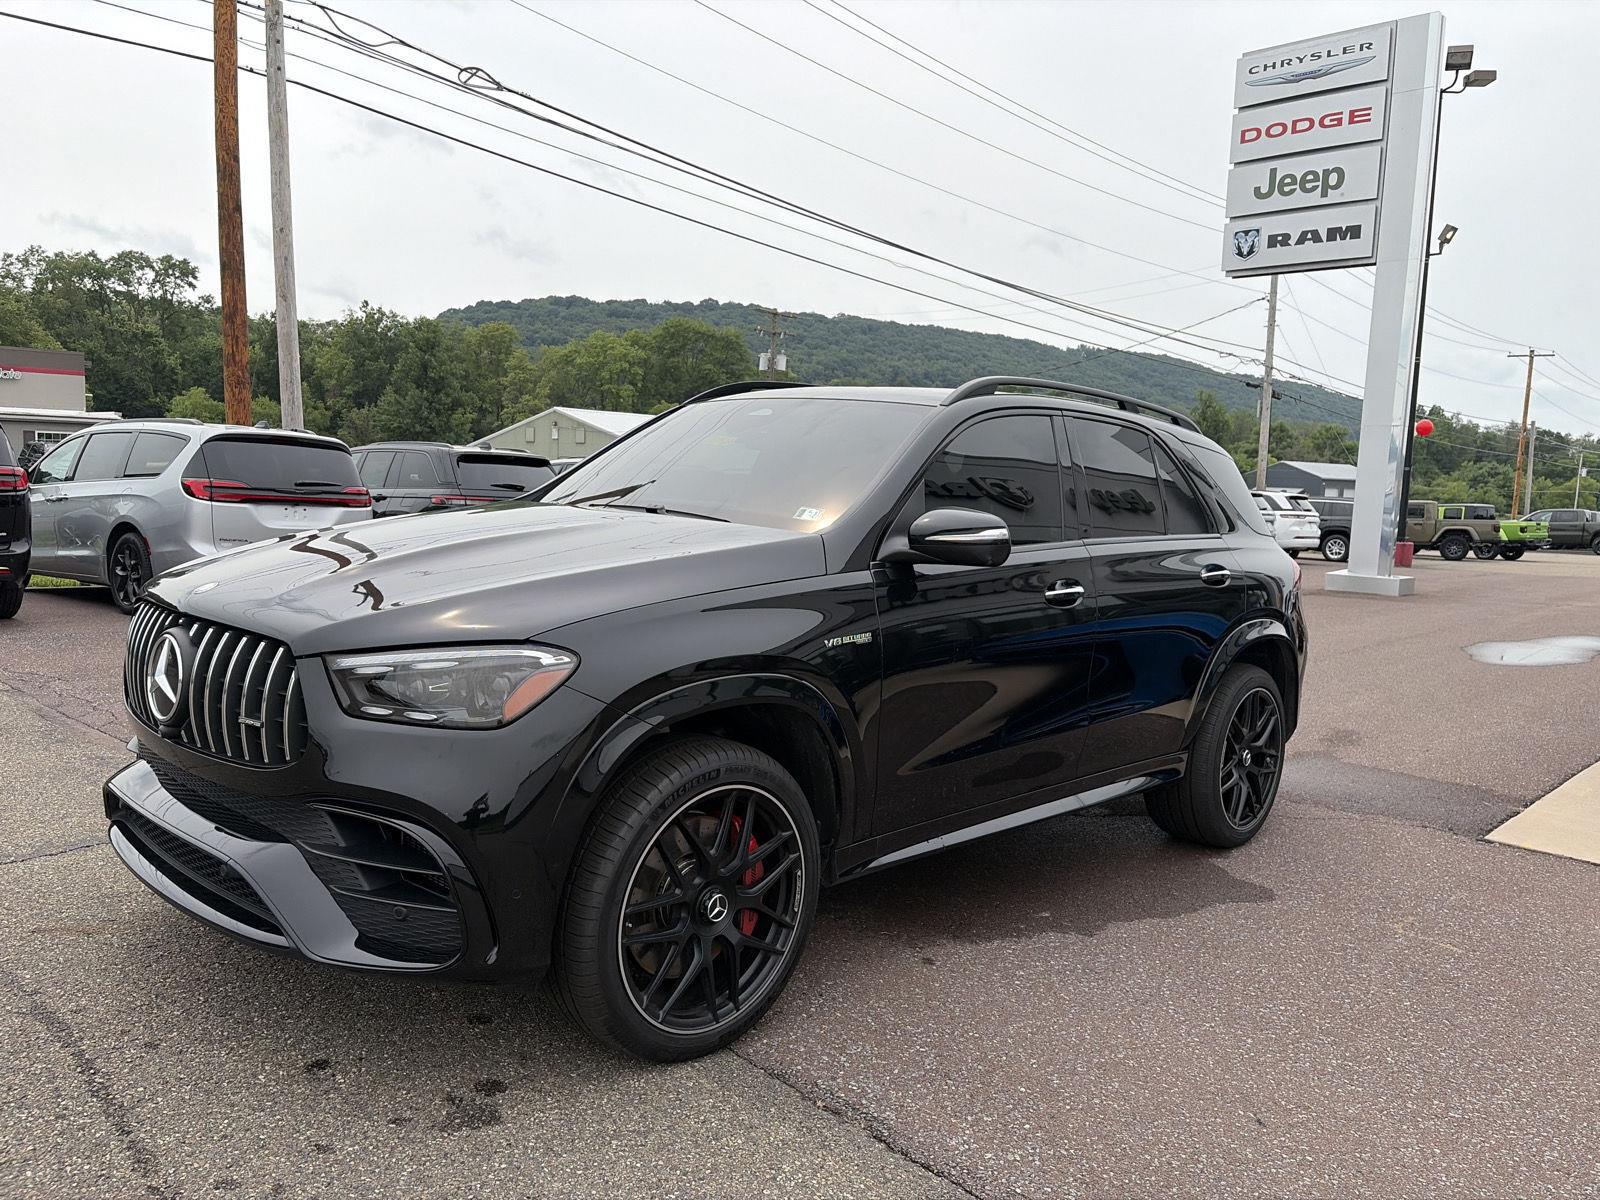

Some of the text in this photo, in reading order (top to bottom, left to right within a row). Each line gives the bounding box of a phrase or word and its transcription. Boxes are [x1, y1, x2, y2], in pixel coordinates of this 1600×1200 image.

[1248, 41, 1374, 75] CHRYSLER
[1239, 106, 1372, 145] DODGE
[1253, 166, 1346, 200] Jeep
[1266, 223, 1362, 250] RAM
[664, 768, 721, 807] MICHELIN
